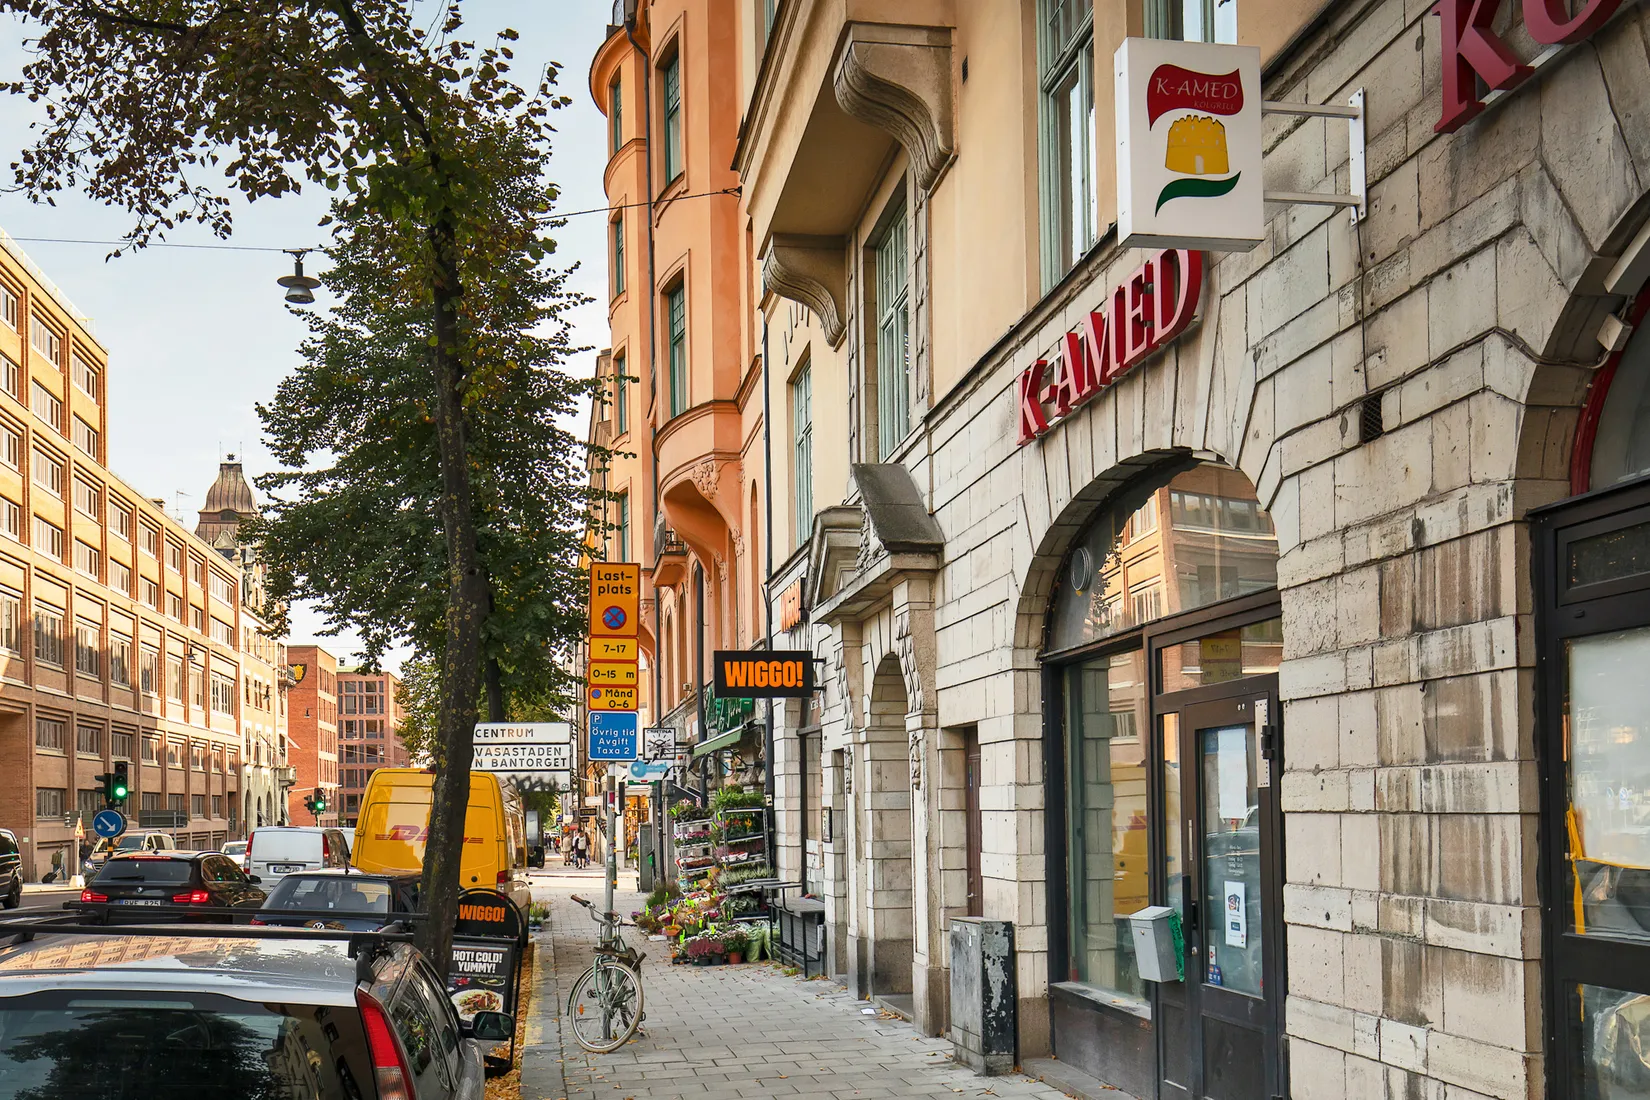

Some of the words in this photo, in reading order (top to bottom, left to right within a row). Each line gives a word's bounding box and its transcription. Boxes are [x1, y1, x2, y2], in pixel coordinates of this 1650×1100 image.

[1156, 77, 1238, 99] K-AMED
[1193, 100, 1235, 110] KOLGRILL
[1016, 249, 1202, 446] K-AMED
[597, 570, 633, 581] Last-
[597, 583, 632, 596] plats
[603, 644, 626, 653] 7-17
[592, 669, 617, 679] 0-15
[625, 671, 635, 679] m
[724, 660, 803, 688] WIGGO!
[605, 688, 633, 698] Månd
[608, 699, 629, 708] 0-6
[594, 714, 601, 723] P
[475, 728, 534, 738] CENTRUM
[592, 726, 619, 737] Övrig
[622, 728, 635, 736] tid
[598, 738, 628, 747] Avgift
[475, 746, 562, 757] VASASTADEN
[596, 746, 620, 755] Taxa
[623, 747, 630, 755] 2
[475, 758, 483, 768] N
[491, 757, 567, 768] BANTORGET
[459, 903, 506, 923] WIGGO!
[452, 950, 475, 962] HOT!
[475, 952, 503, 964] COLD!
[458, 961, 496, 974] YUMMY!
